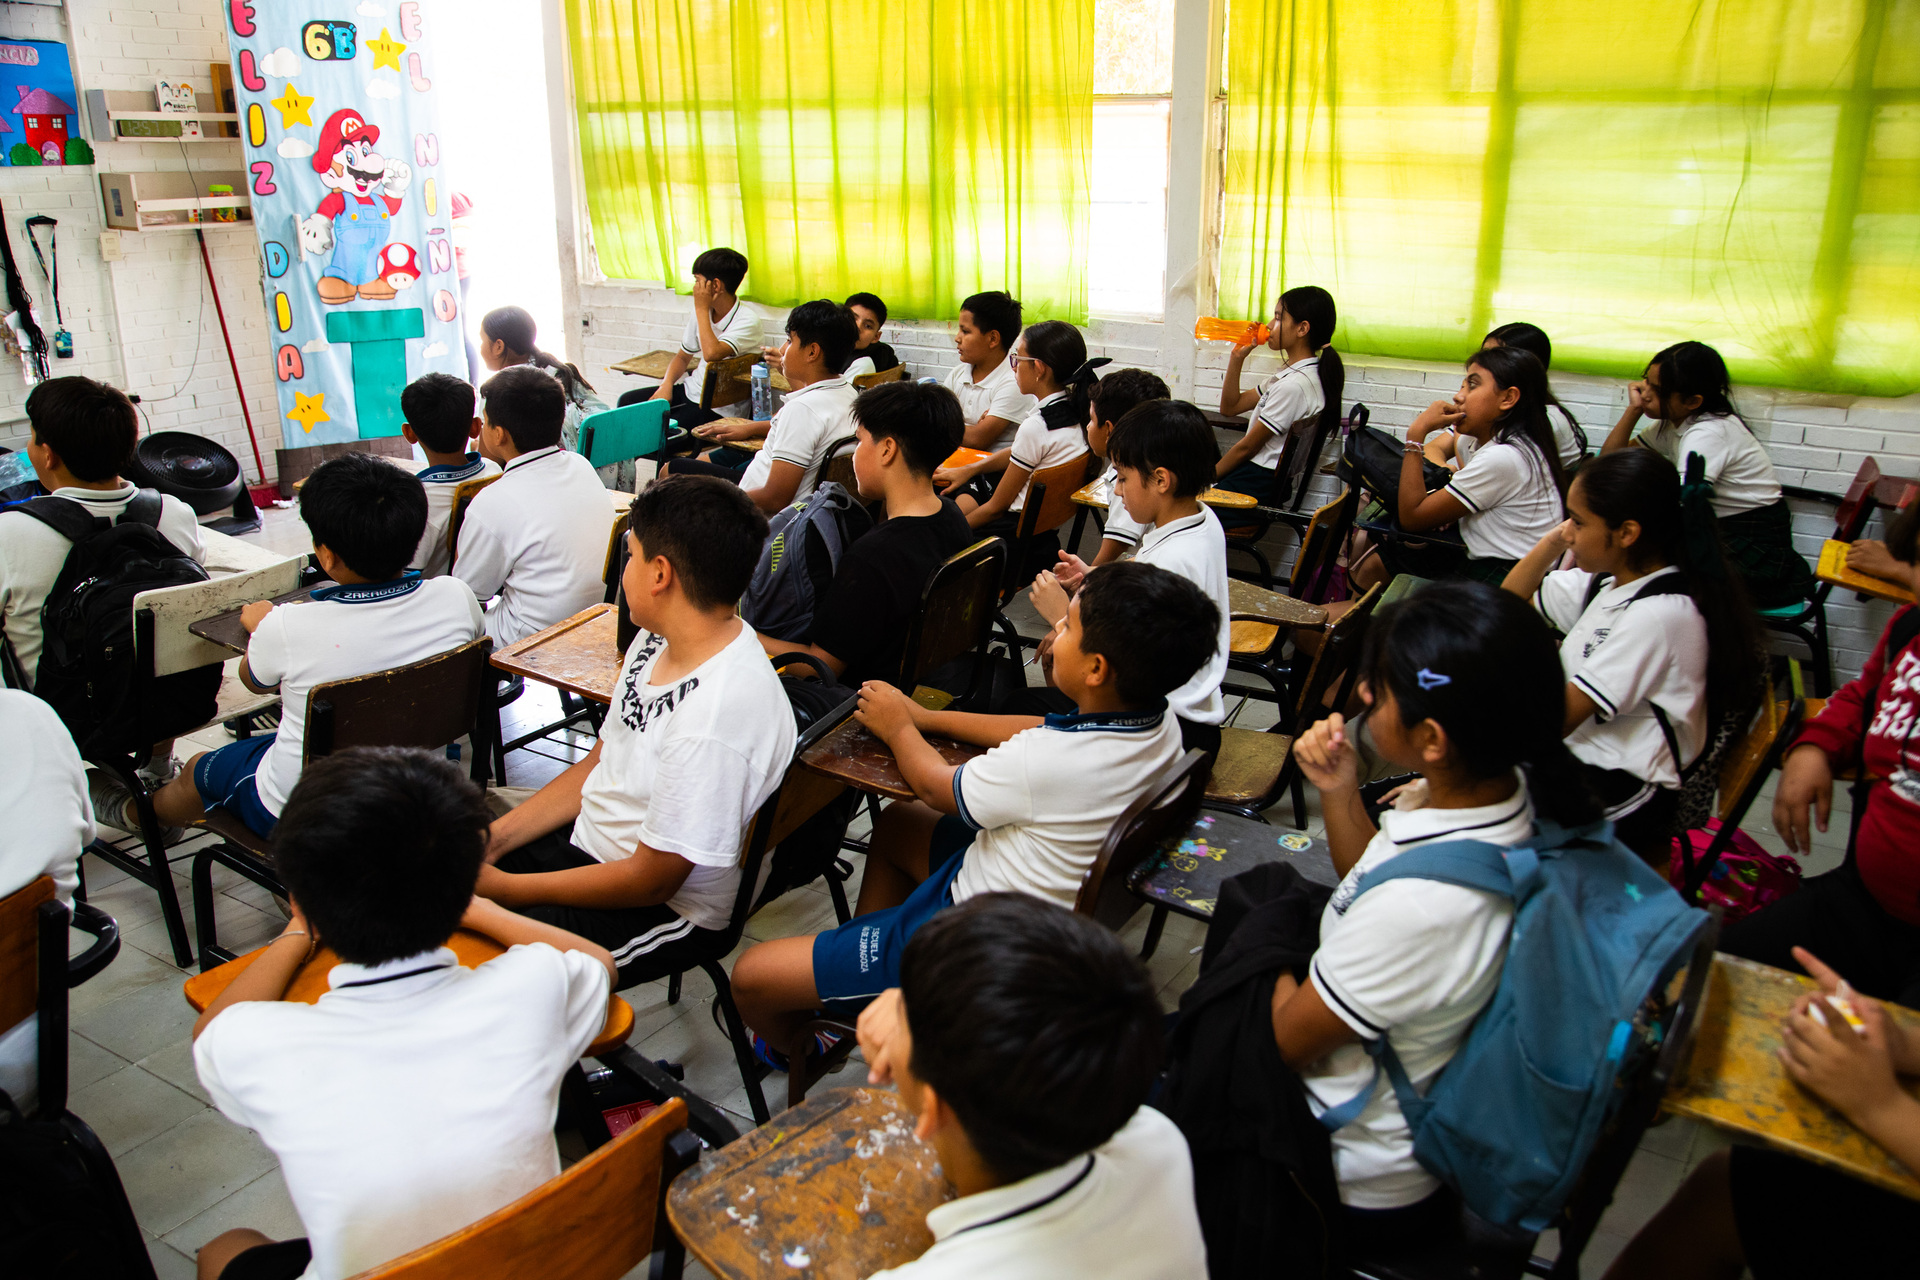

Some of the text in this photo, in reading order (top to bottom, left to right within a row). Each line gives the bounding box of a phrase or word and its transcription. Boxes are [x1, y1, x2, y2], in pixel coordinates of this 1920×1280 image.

[415, 133, 457, 323] NIÑO
[263, 241, 304, 382] DIA
[344, 584, 409, 599] ZARAGOZA
[870, 927, 880, 963] ESCUELA
